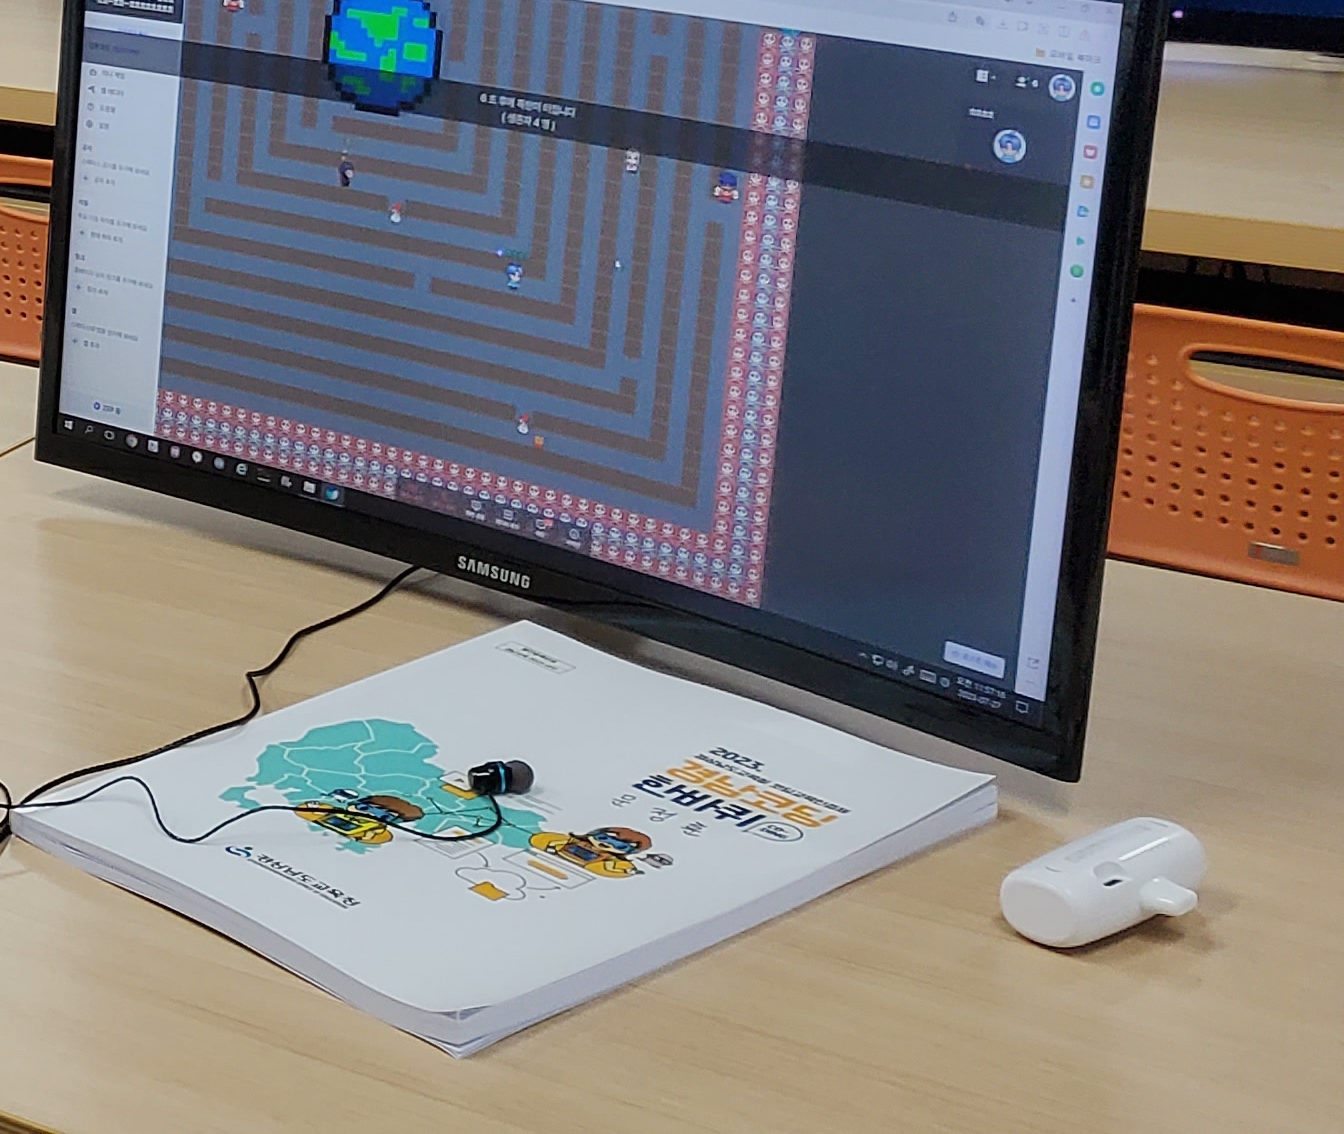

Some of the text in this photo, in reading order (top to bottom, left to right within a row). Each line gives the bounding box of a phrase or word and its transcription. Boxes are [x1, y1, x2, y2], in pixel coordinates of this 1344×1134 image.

[457, 555, 531, 589] SAMSUNG
[709, 746, 765, 773] 2023.
[632, 774, 767, 828] 한바퀴
[666, 759, 839, 829] 경남코딩
[257, 853, 361, 907] 경상남도교육청
